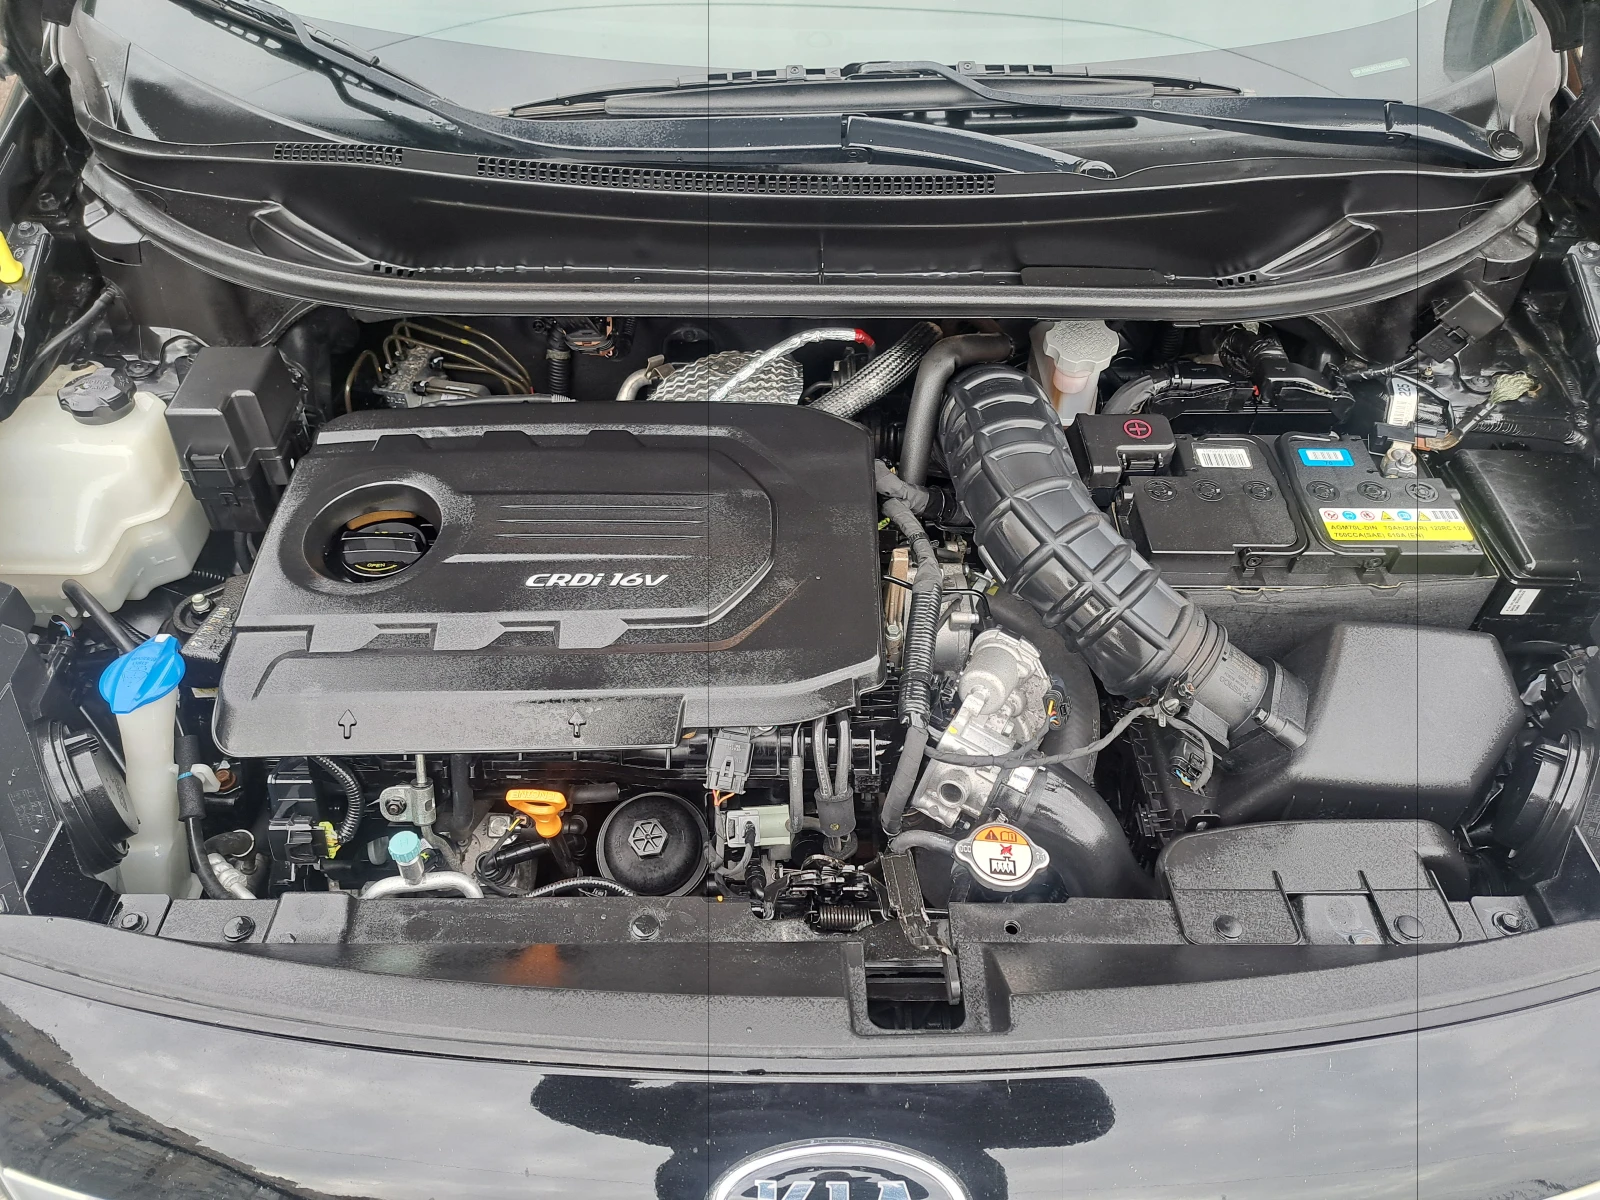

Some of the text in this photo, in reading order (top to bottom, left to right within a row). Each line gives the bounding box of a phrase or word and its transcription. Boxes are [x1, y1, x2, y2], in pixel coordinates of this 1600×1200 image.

[1397, 383, 1411, 397] 225
[525, 573, 669, 587] CRDi 16V
